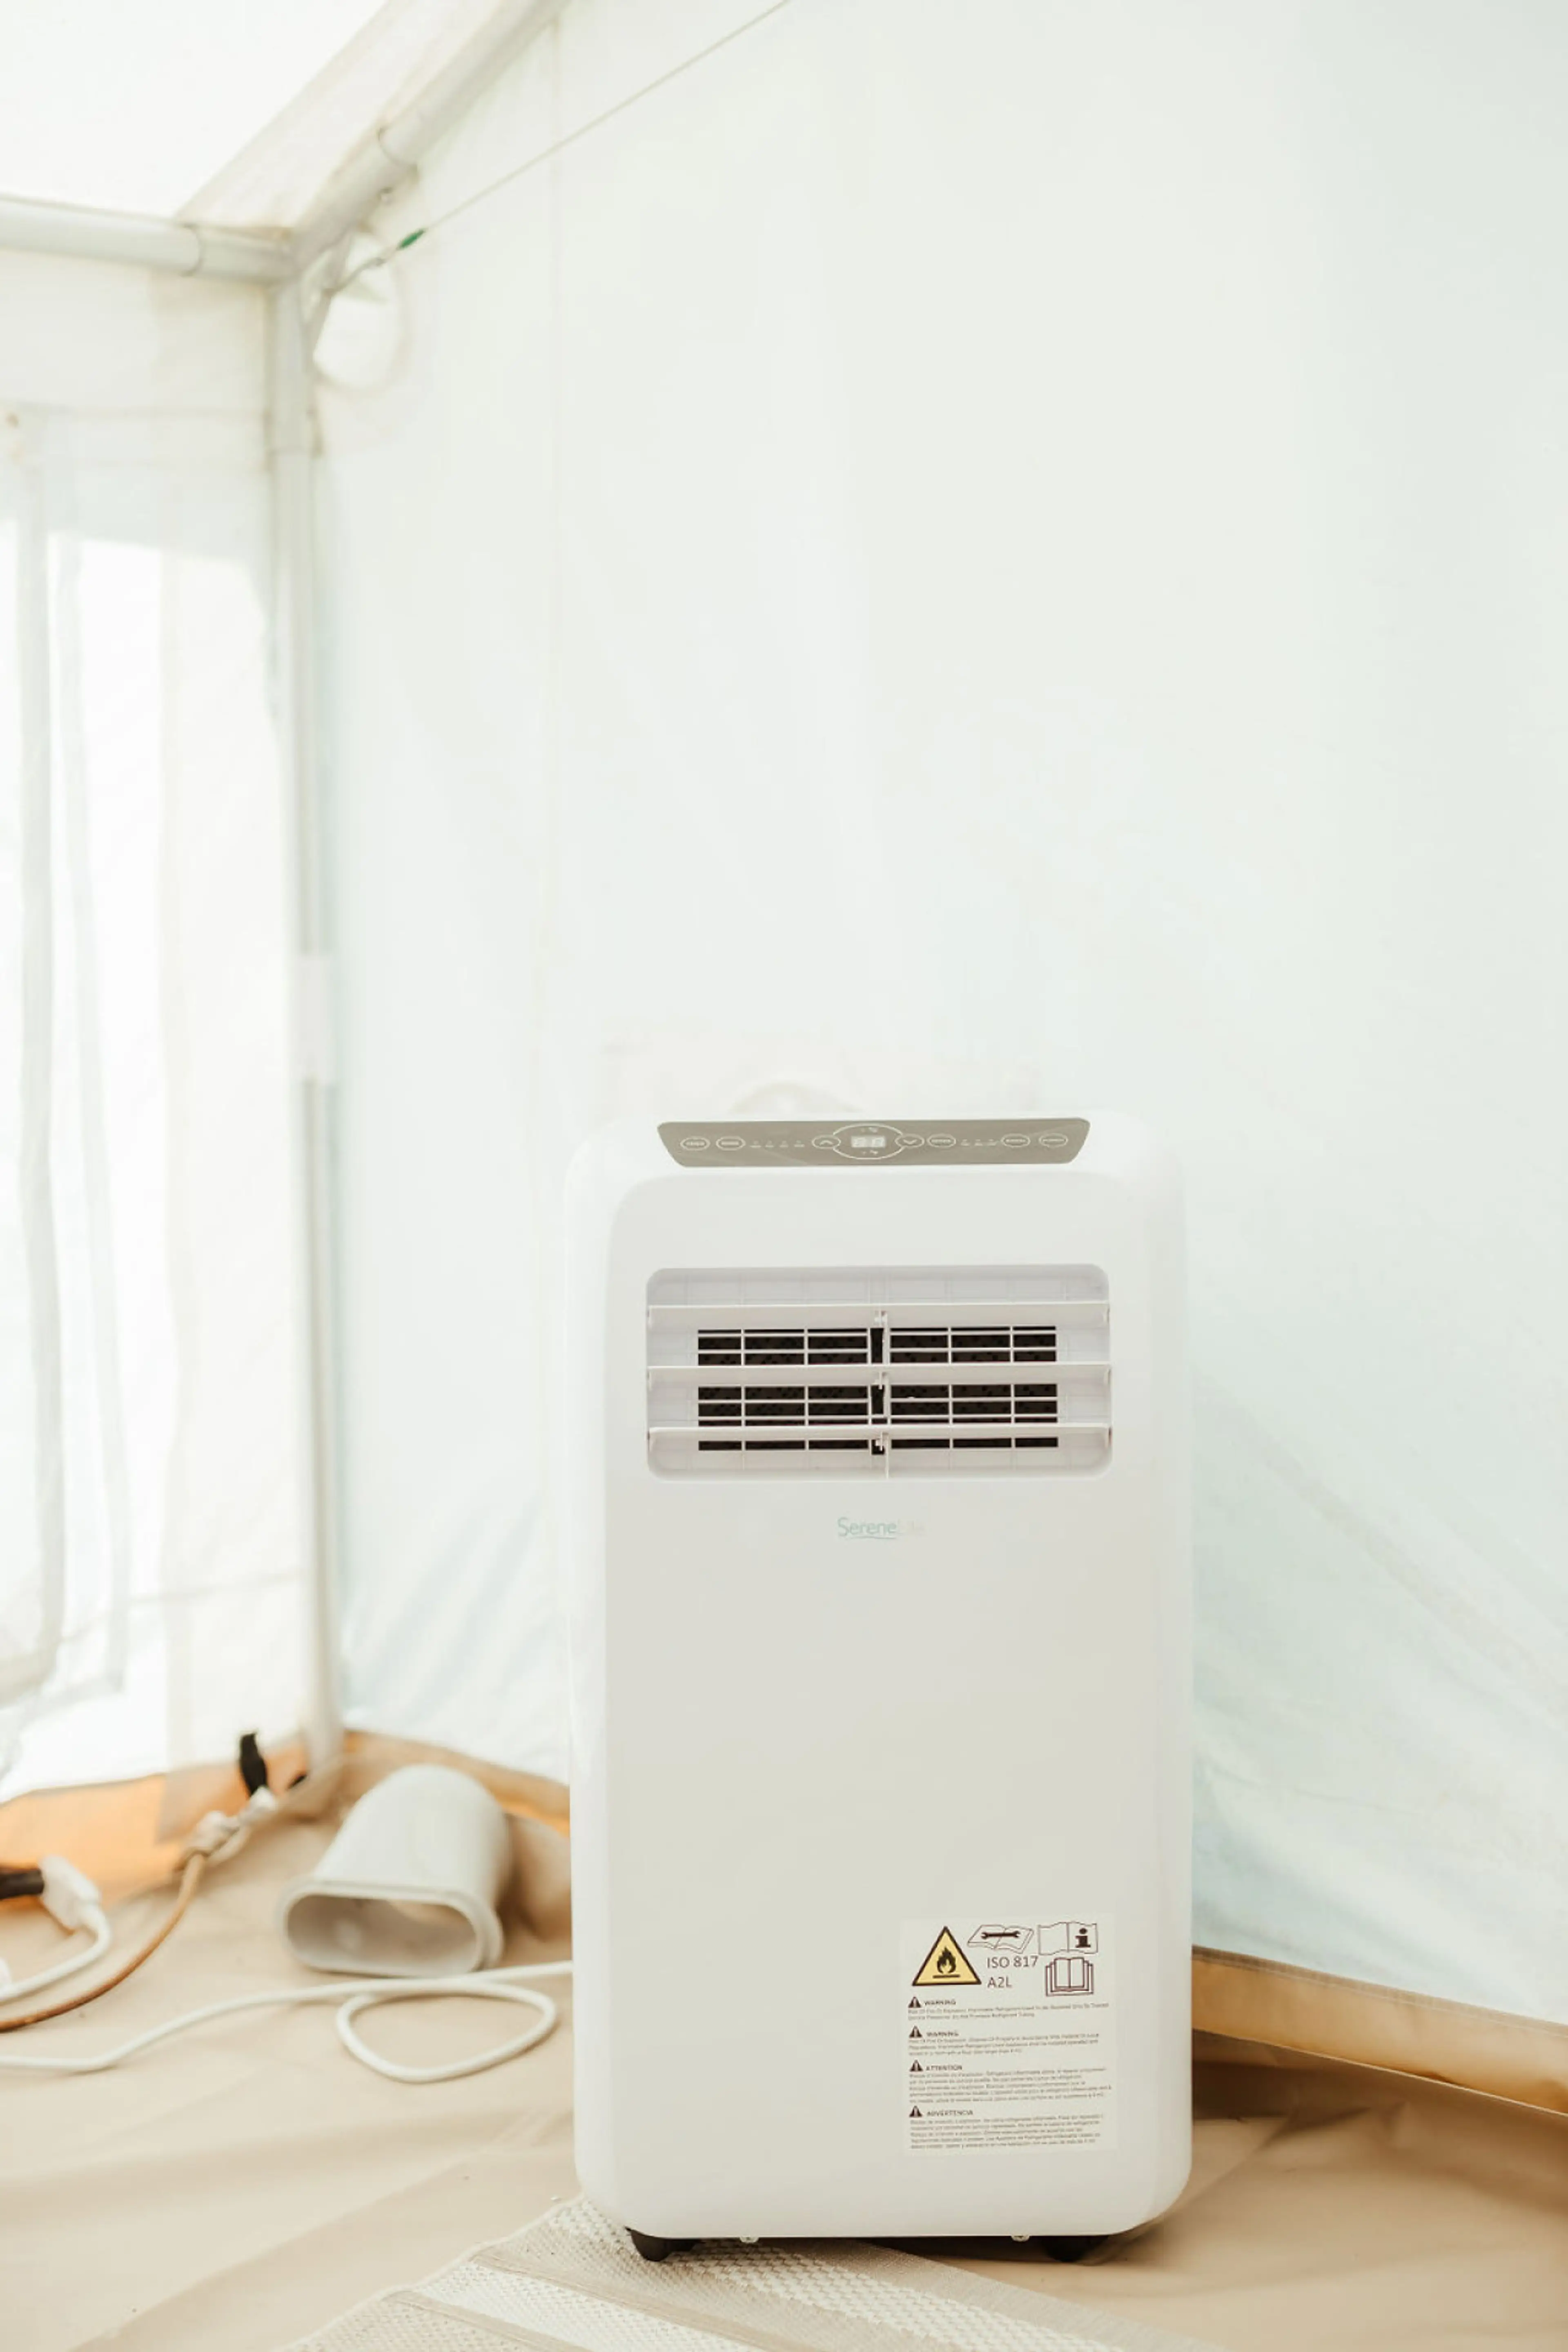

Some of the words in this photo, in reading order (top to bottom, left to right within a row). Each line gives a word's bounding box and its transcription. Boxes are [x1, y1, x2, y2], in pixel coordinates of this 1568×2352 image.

[987, 1957, 1010, 1969] ISO
[1013, 1956, 1038, 1968] 817
[987, 1976, 1012, 1988] A2L
